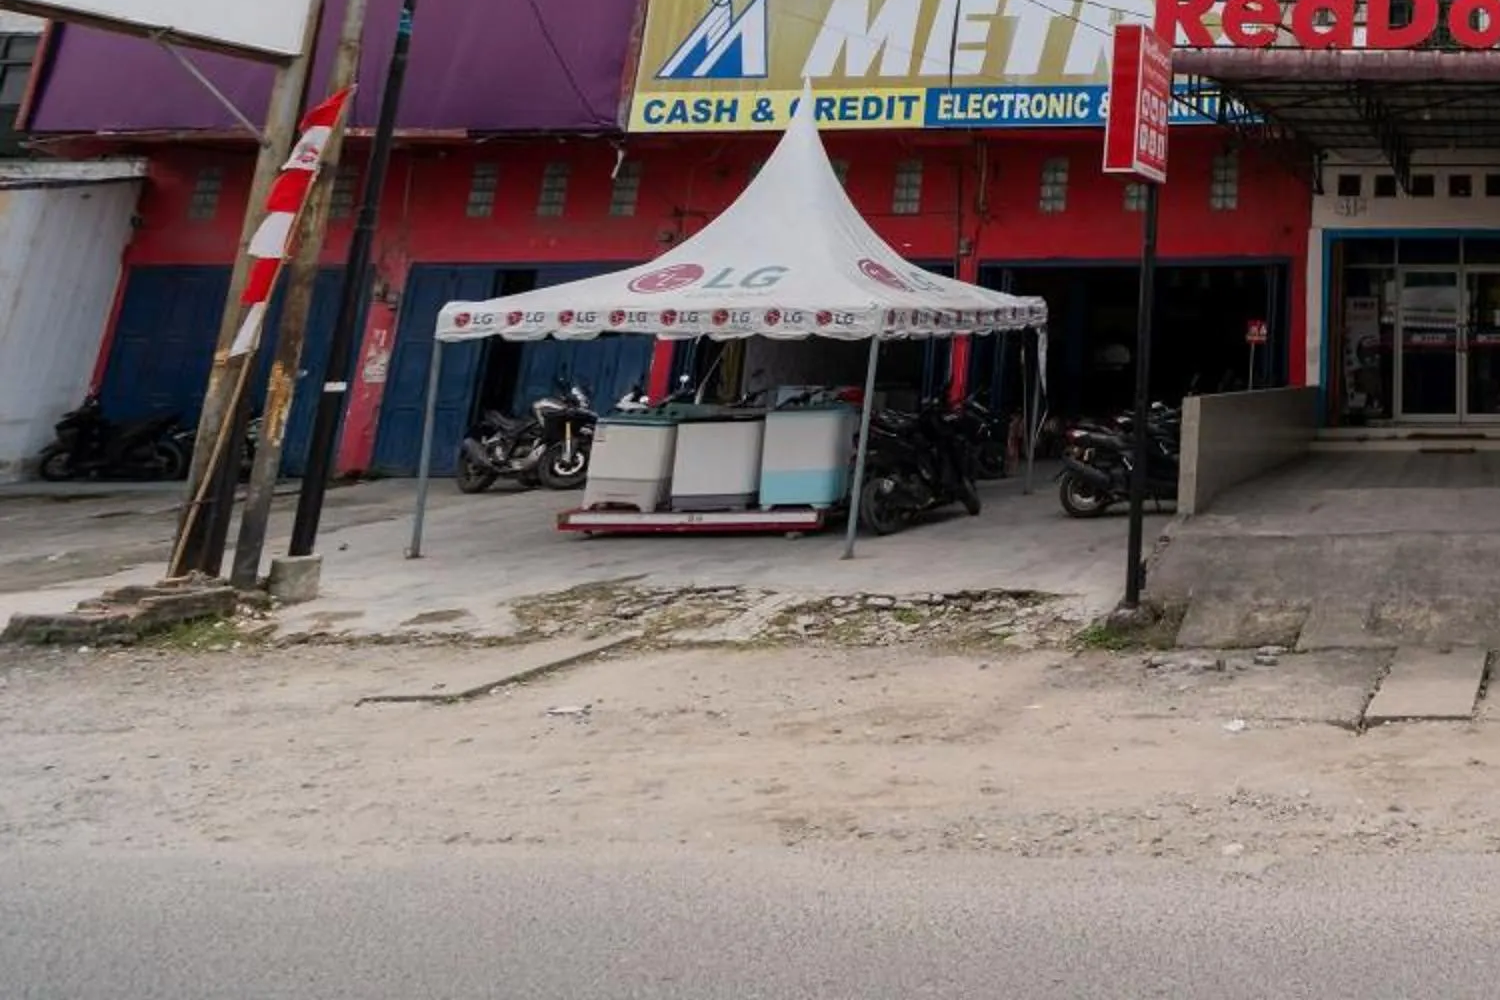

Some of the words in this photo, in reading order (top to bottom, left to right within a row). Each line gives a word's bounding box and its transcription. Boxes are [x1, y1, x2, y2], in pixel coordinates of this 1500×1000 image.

[643, 98, 738, 125] CASH
[751, 97, 775, 123] &
[937, 90, 1090, 120] ELECTRONIC
[702, 265, 790, 289] LG
[472, 313, 494, 325] LG
[525, 312, 546, 323] LG
[575, 312, 597, 324] LG
[627, 311, 648, 324] LG
[678, 311, 699, 324] LG
[730, 311, 751, 324] LG
[782, 311, 802, 324] LG
[834, 313, 856, 325] LG
